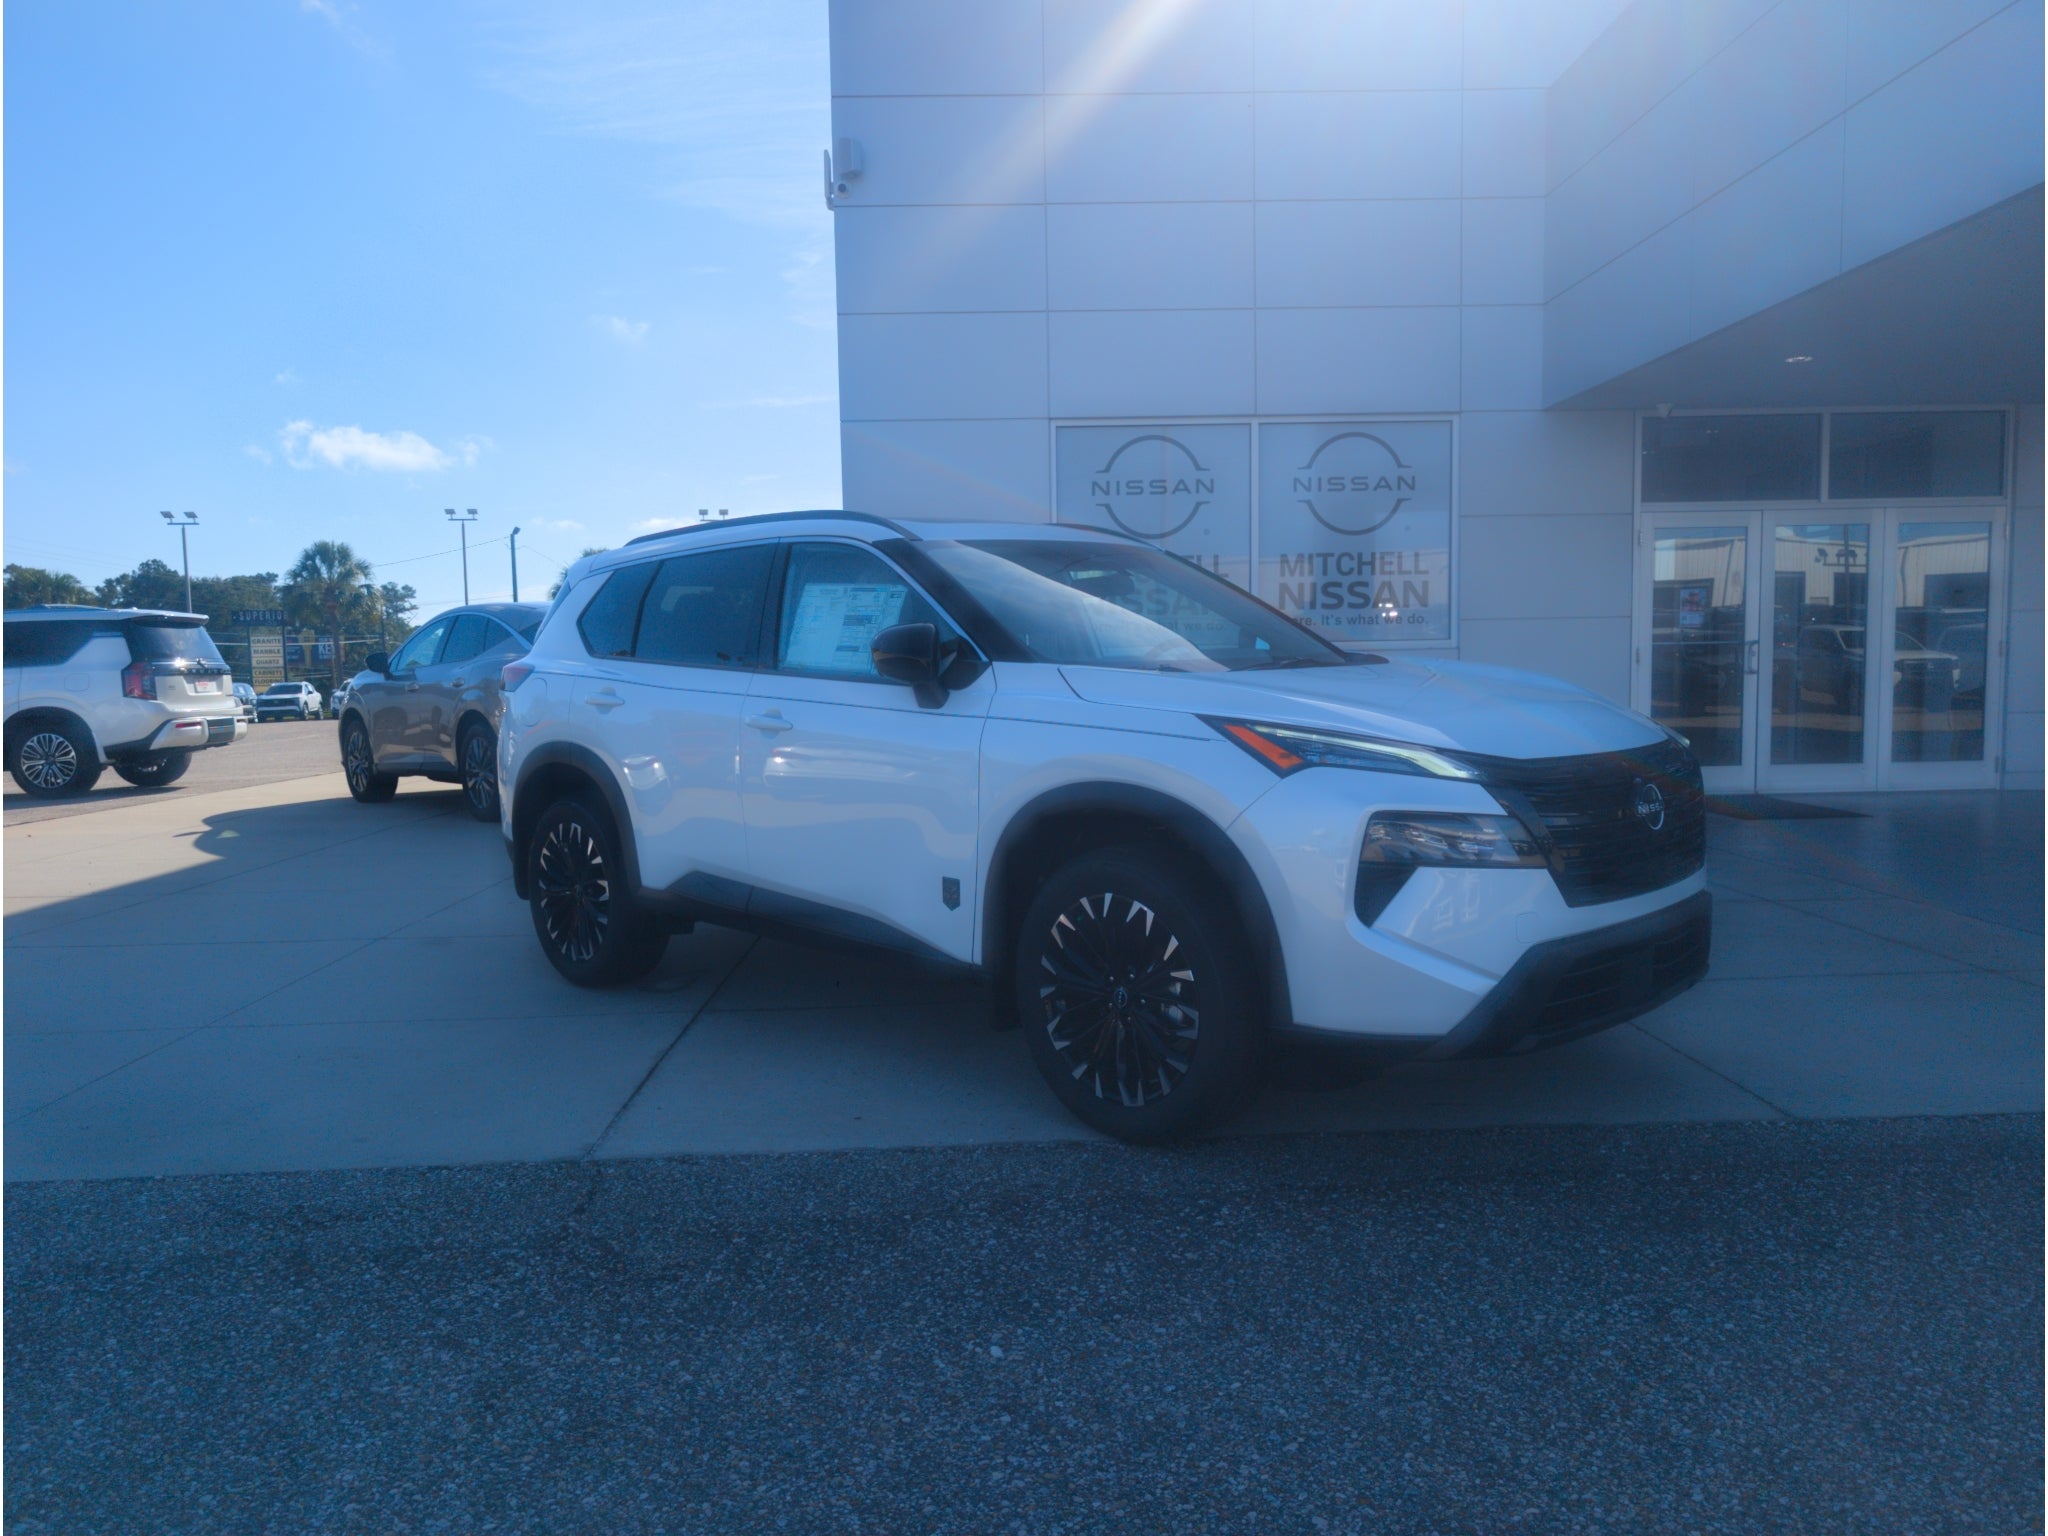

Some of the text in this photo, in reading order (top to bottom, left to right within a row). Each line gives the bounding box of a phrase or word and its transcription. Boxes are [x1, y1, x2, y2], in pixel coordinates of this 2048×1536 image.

[1091, 478, 1215, 497] NISSAN
[1294, 475, 1416, 493] NISSAN
[1279, 551, 1430, 577] MITCHELL
[1278, 580, 1429, 611] NISSAN
[1321, 614, 1343, 626] It's
[1347, 614, 1380, 626] what
[1384, 616, 1403, 626] we
[1407, 613, 1430, 625] do.
